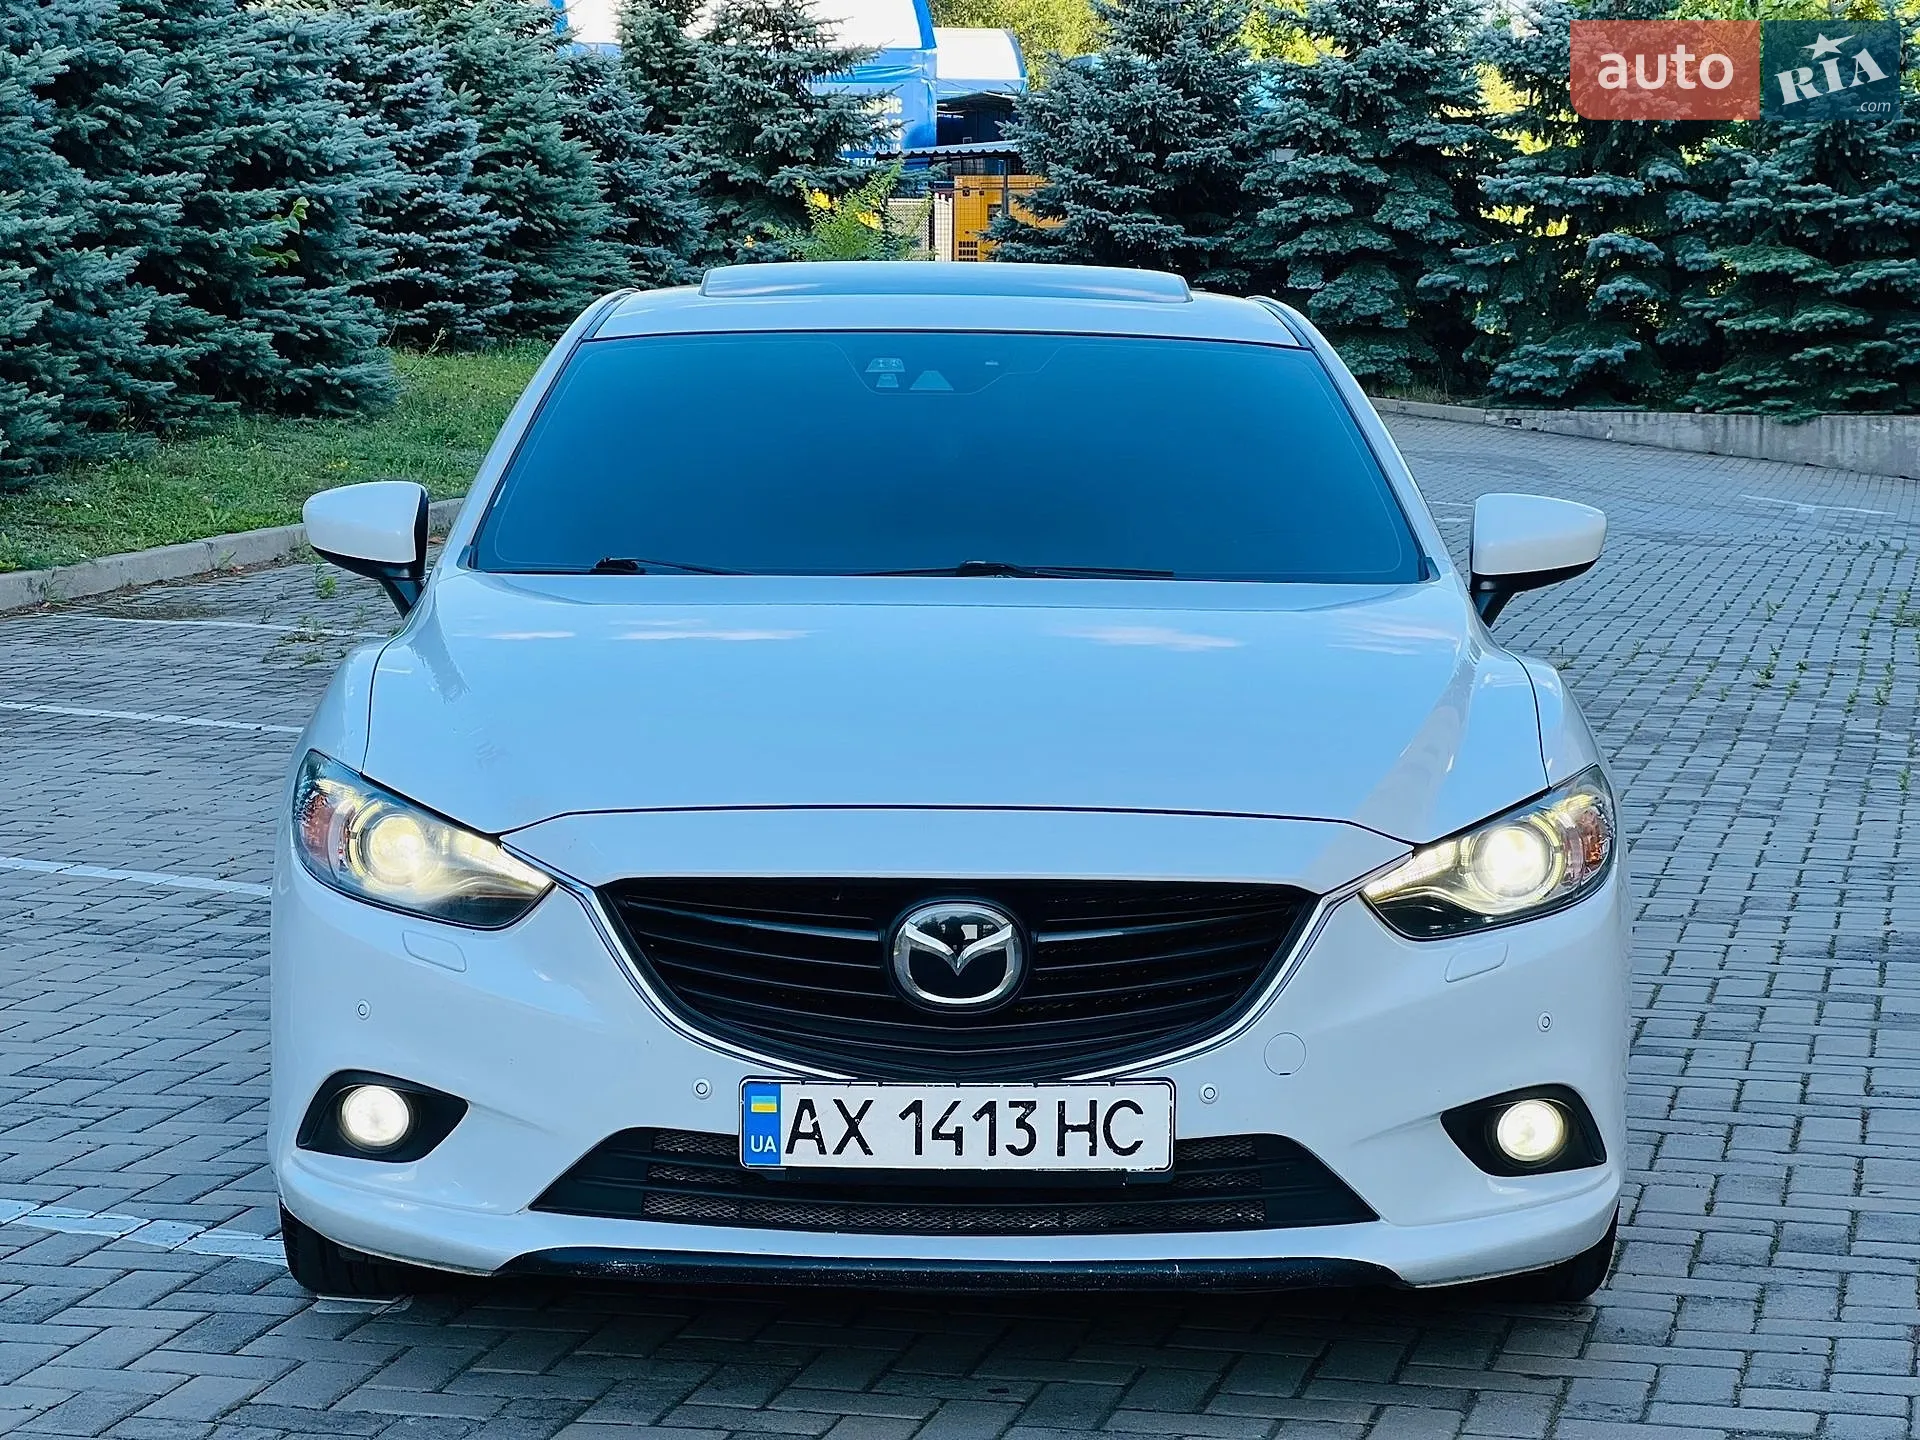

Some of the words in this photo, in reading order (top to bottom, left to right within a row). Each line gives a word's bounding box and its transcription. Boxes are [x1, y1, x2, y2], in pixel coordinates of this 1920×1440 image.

[750, 1135, 777, 1153] UA
[785, 1098, 873, 1156] AX
[898, 1099, 1037, 1157] 1413
[1056, 1099, 1144, 1157] HC
